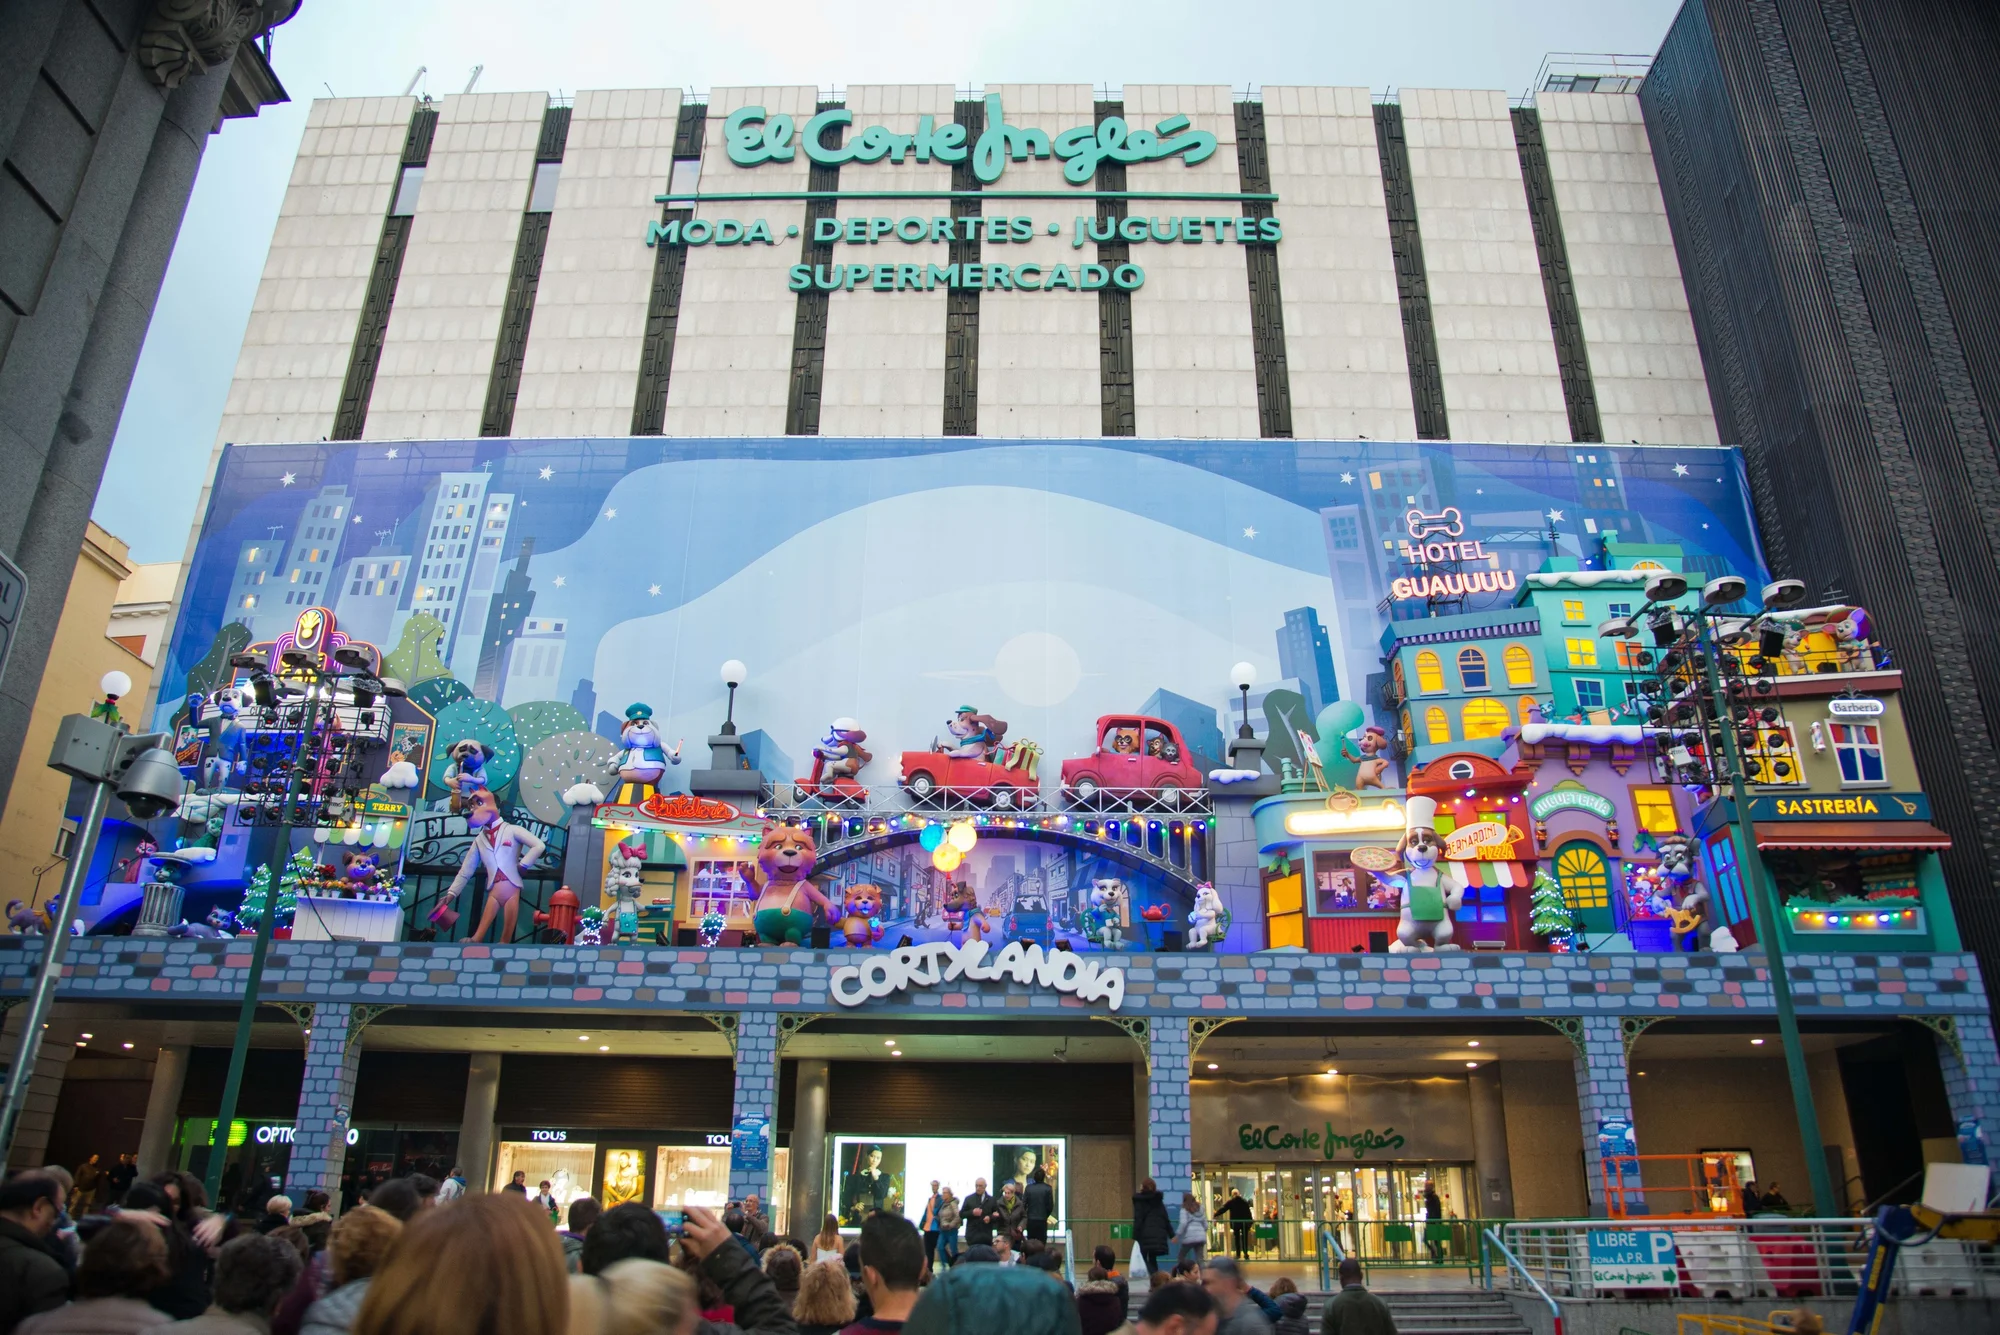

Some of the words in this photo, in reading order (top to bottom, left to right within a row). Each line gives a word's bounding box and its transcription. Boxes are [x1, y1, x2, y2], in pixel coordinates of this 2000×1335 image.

[724, 106, 796, 168] El
[802, 109, 968, 166] Corte
[973, 92, 1218, 186] Inglés
[646, 218, 774, 247] MODA
[814, 216, 1033, 244] DEPORTES
[1072, 216, 1283, 249] JUGUETES
[788, 263, 1145, 292] SUPERMERCADO
[1407, 540, 1491, 563] HOTEL
[1392, 569, 1516, 599] GUAUUUU
[372, 802, 403, 812] TERRY
[1776, 796, 1879, 815] SASTRERÍA
[425, 818, 454, 839] EL
[1446, 823, 1498, 857] BERNARDINI
[1476, 844, 1517, 860] PIZZA
[830, 938, 1125, 1012] CORTYLANDIA
[256, 1126, 296, 1144] OPTIC
[532, 1130, 567, 1141] TOUS
[706, 1134, 732, 1145] TOU
[1238, 1123, 1263, 1151] El
[1263, 1125, 1321, 1151] Corte
[1323, 1121, 1405, 1160] Inglés
[1596, 1232, 1638, 1247] LIBRE
[1649, 1232, 1673, 1264] P
